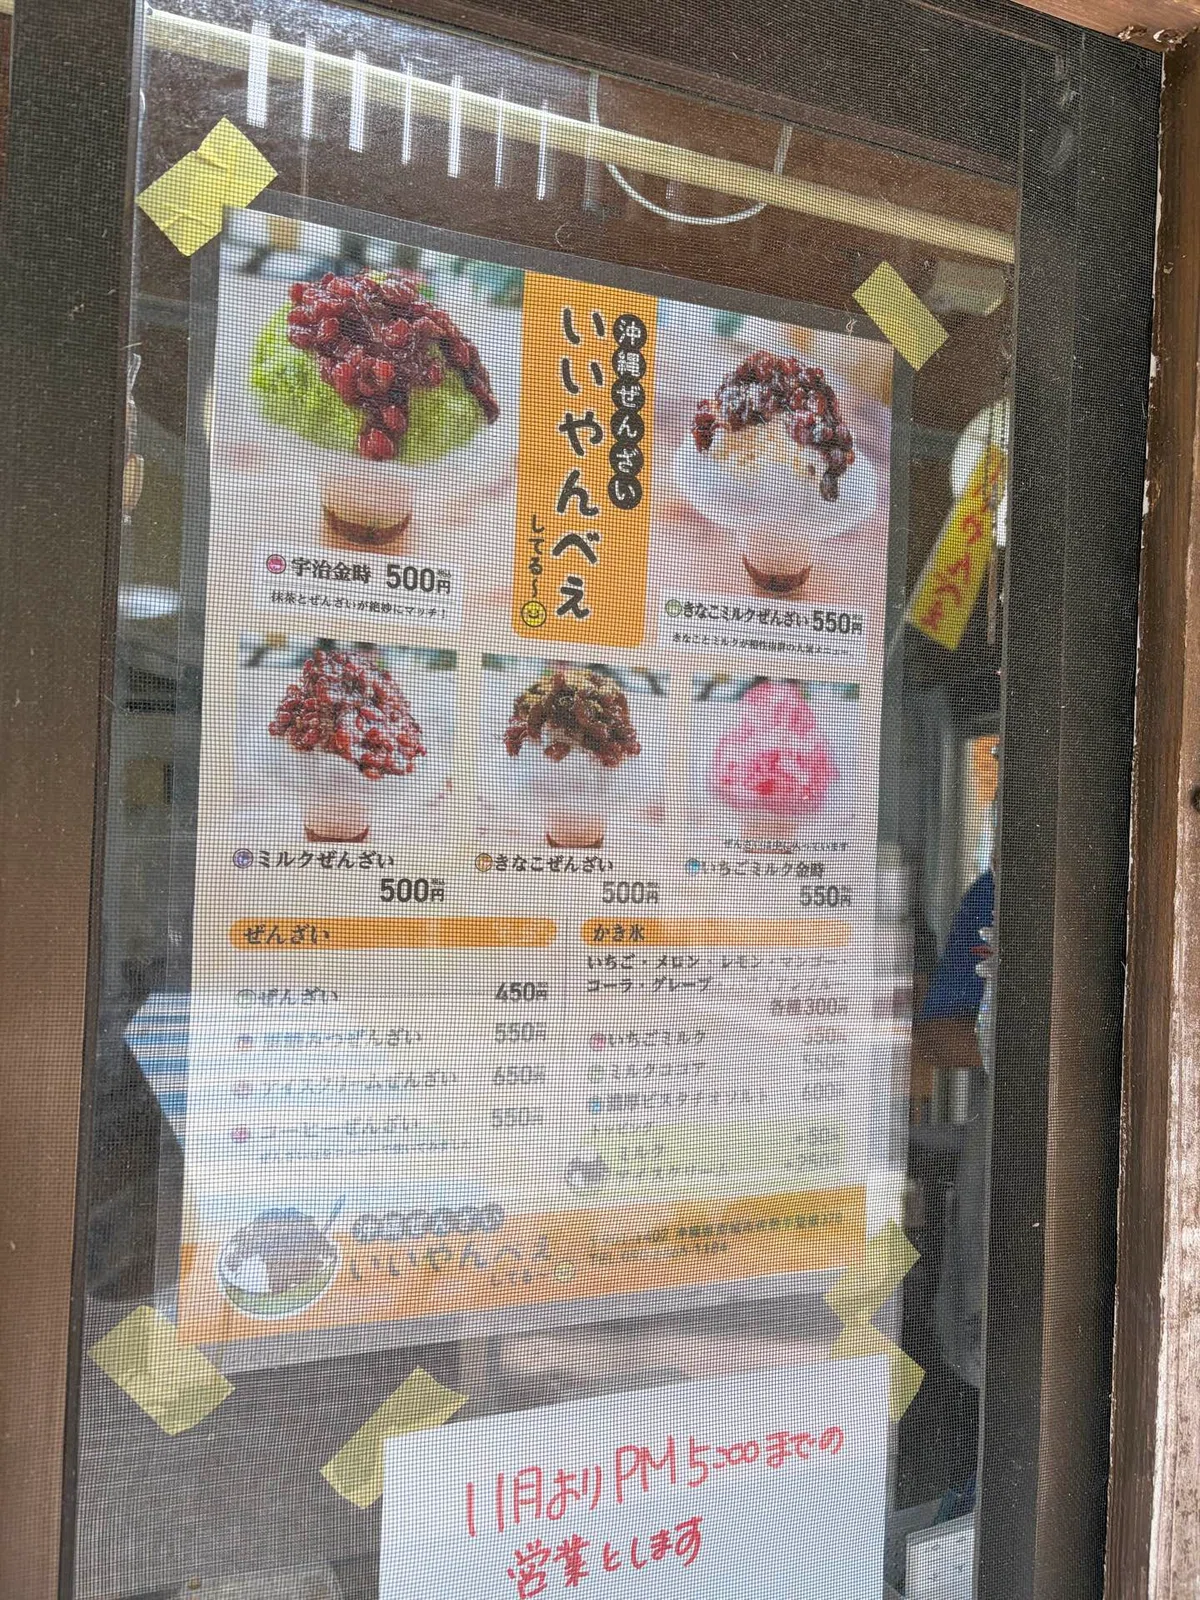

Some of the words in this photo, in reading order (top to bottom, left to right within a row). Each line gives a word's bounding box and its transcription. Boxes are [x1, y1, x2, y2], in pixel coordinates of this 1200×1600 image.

[611, 316, 646, 507] 沖縄ぜんざい
[552, 307, 605, 620] いいやんべえ
[291, 557, 371, 584] 宇治金時
[683, 601, 809, 628] きなこミルクぜんざい
[257, 850, 395, 869] ミルクぜんざい
[494, 853, 614, 873] きなこぜんざい
[702, 860, 825, 879] いちごミルク金時
[243, 924, 330, 944] ぜんざい
[592, 924, 645, 942] かき氷
[258, 987, 339, 1007] ぜんざい
[608, 1030, 706, 1048] いちごミルク
[507, 1516, 705, 1600] 営業とします
